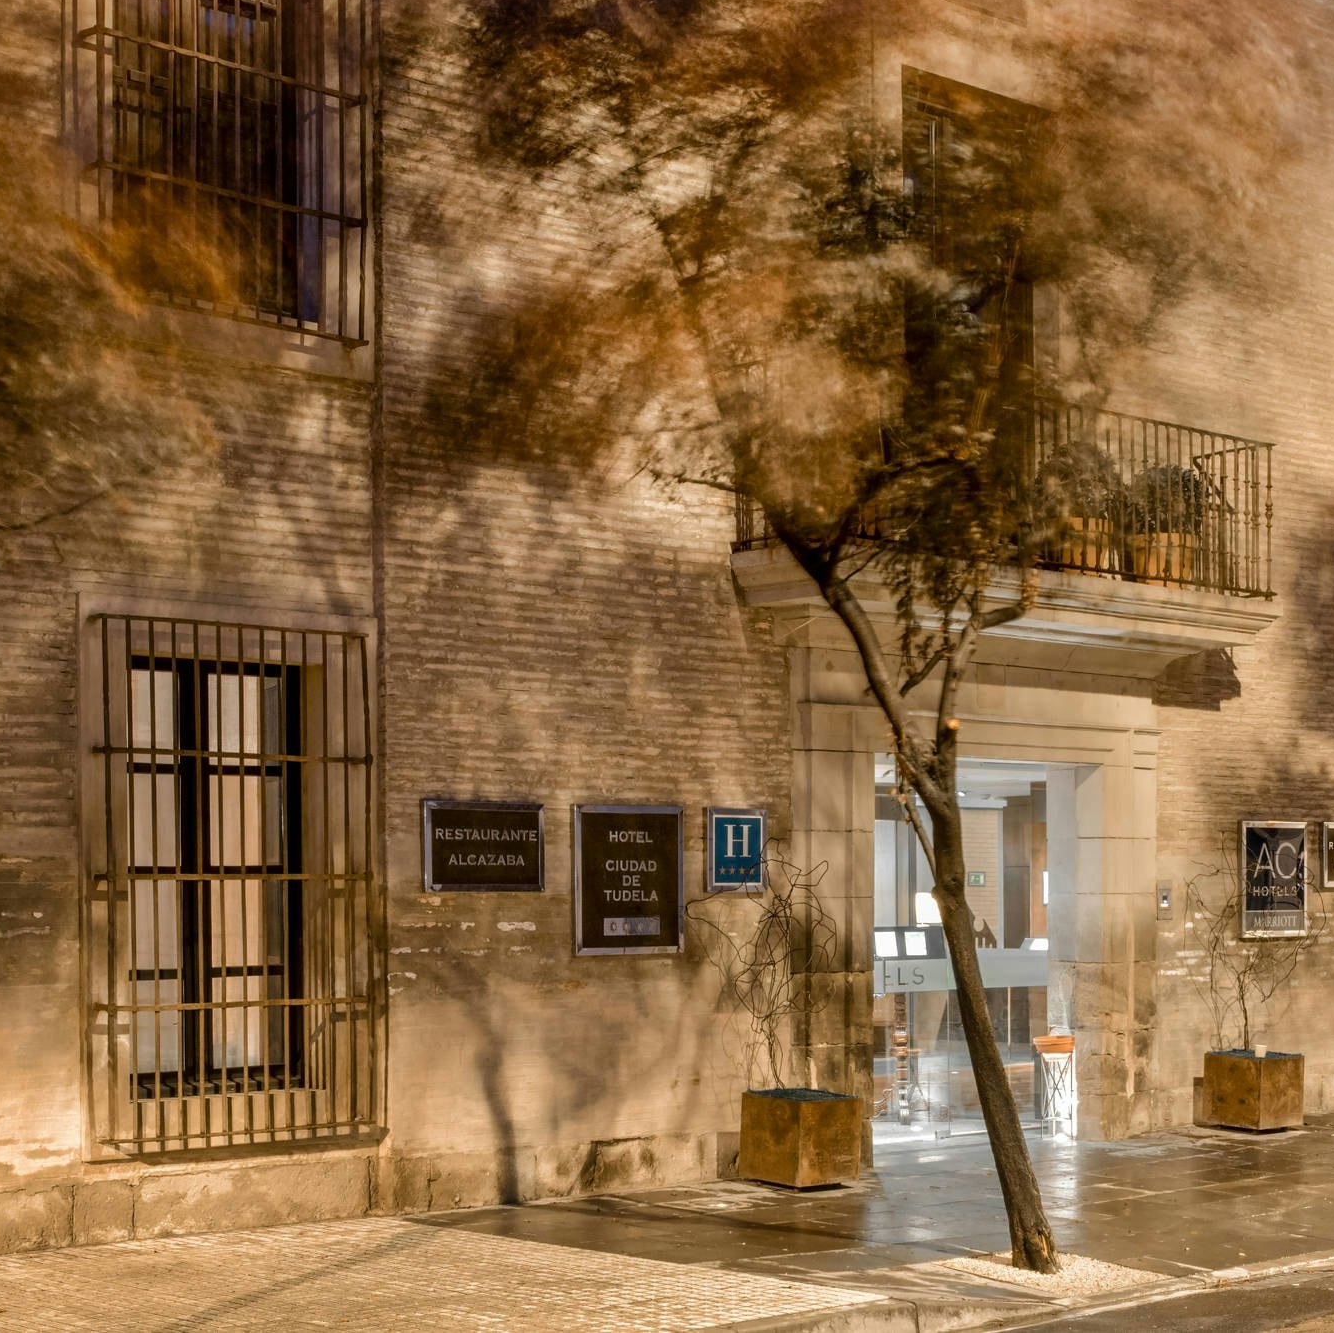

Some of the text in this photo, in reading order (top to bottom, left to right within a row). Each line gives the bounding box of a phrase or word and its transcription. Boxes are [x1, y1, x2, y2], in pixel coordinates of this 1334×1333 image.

[435, 828, 537, 842] RESTAURANTE
[609, 831, 653, 843] HOTEL
[725, 825, 751, 857] H
[449, 854, 525, 867] ALCAZABA
[605, 859, 657, 872] CIUDAD
[1254, 842, 1297, 878] AC
[622, 874, 641, 887] DE
[604, 889, 658, 902] TUDELA
[1253, 885, 1297, 897] HOTELS
[1254, 915, 1297, 928] MARRIOTT
